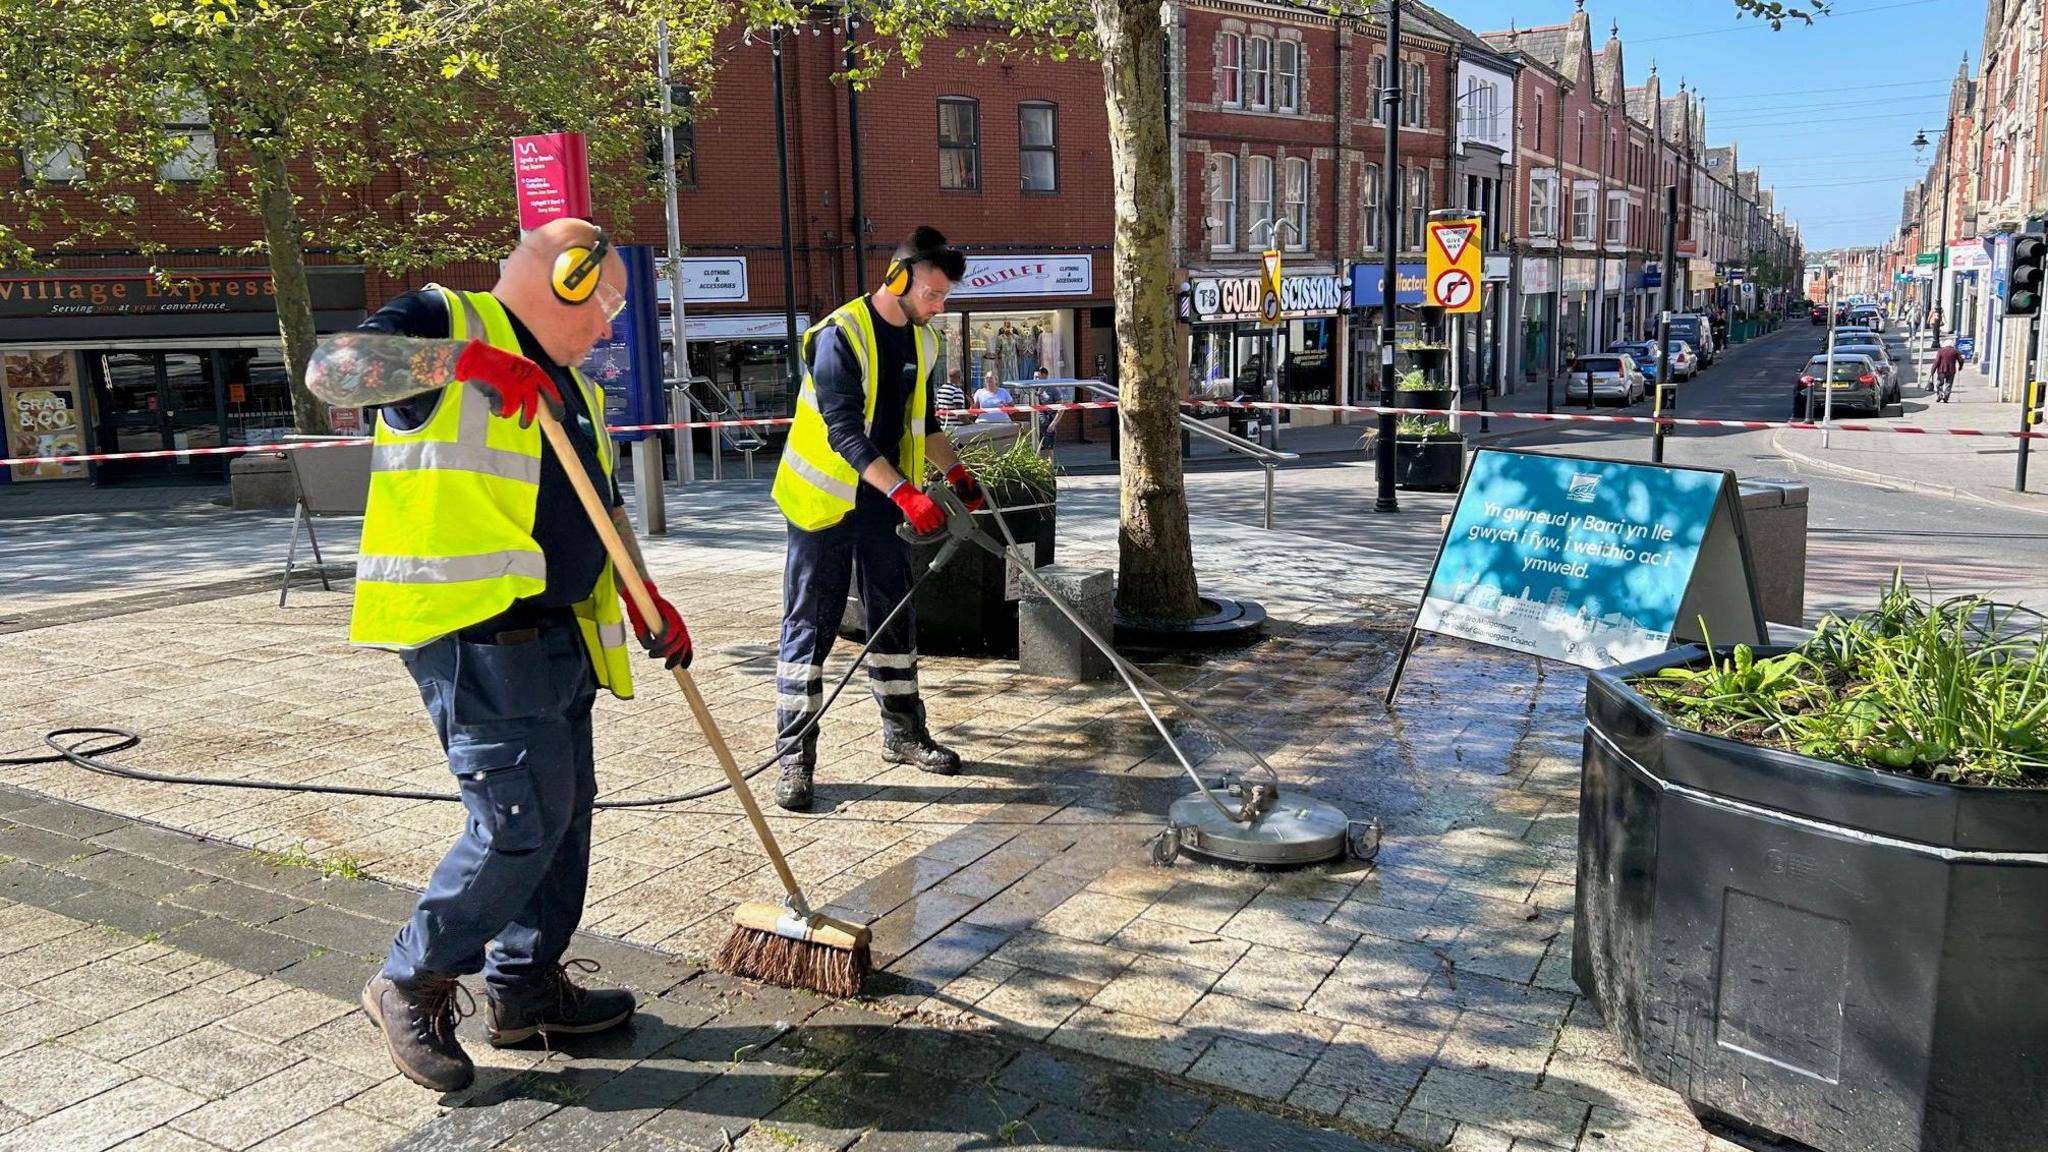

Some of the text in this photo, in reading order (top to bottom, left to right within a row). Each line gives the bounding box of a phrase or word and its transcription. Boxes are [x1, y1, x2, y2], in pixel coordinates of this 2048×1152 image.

[971, 264, 1046, 288] OUTLET
[0, 278, 274, 305] Village Express
[1222, 277, 1342, 313] GOLD SCISSORS
[51, 303, 93, 313] Serving
[118, 304, 130, 312] at
[17, 397, 67, 411] GRAB
[21, 410, 68, 426] & GO
[1484, 501, 1673, 542] Yn gwneud y Barri yn lle
[1468, 524, 1672, 567] gwych i fyw, i weithio ac i
[1522, 556, 1590, 579] ymweld.
